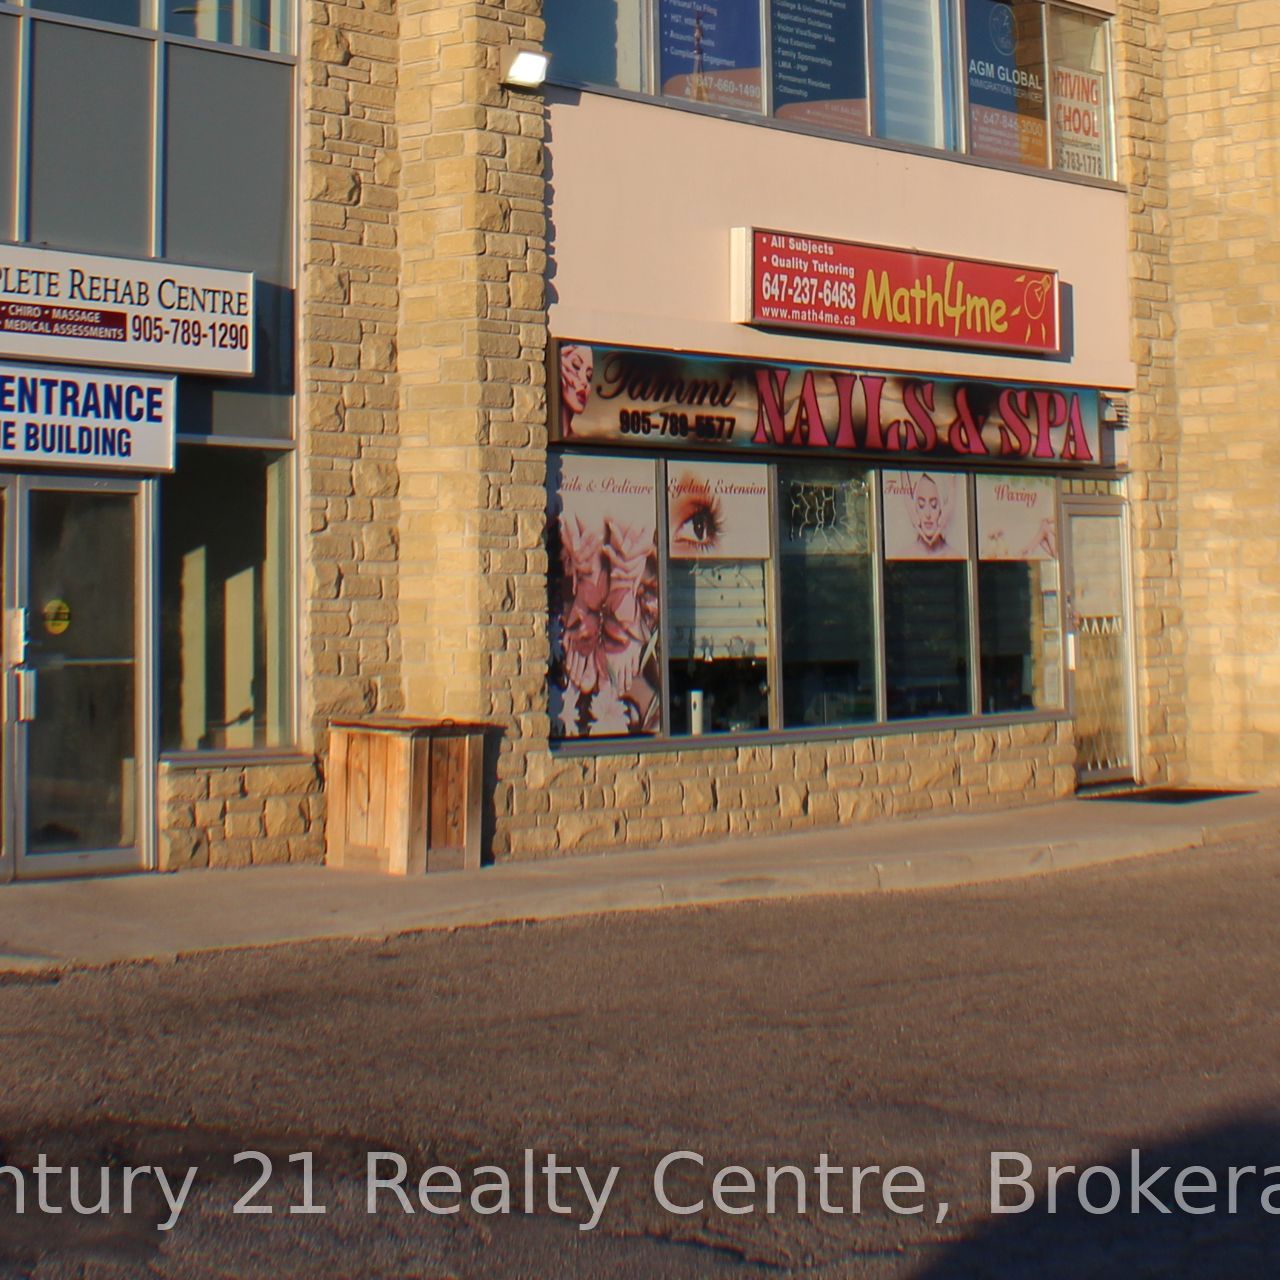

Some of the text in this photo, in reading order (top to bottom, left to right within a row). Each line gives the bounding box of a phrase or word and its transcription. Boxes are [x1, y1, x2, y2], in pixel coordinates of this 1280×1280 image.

[968, 58, 1044, 90] AGM GLOBAL
[770, 235, 834, 256] All Subjects
[770, 253, 855, 279] Quality Tutoring
[68, 269, 150, 308] REHAB
[156, 277, 250, 318] CENTRE
[761, 271, 856, 310] 647-237-6463
[862, 260, 1010, 337] Math4me
[8, 303, 42, 318] CHIRO
[51, 308, 102, 324] MASSAGE
[761, 306, 856, 326] www.math4me.ca
[3, 318, 51, 334] MEDICAL
[52, 323, 125, 340] ASSESSMENTS
[131, 314, 250, 352] 905-789-1290
[595, 350, 737, 408] Tammi
[751, 368, 1094, 462] NAILS & SPA
[23, 421, 132, 458] BUILDING
[560, 475, 582, 493] ails
[586, 479, 597, 493] &
[667, 478, 768, 499] Eyelash Extension
[884, 480, 918, 496] Facial
[994, 484, 1038, 508] Waxing
